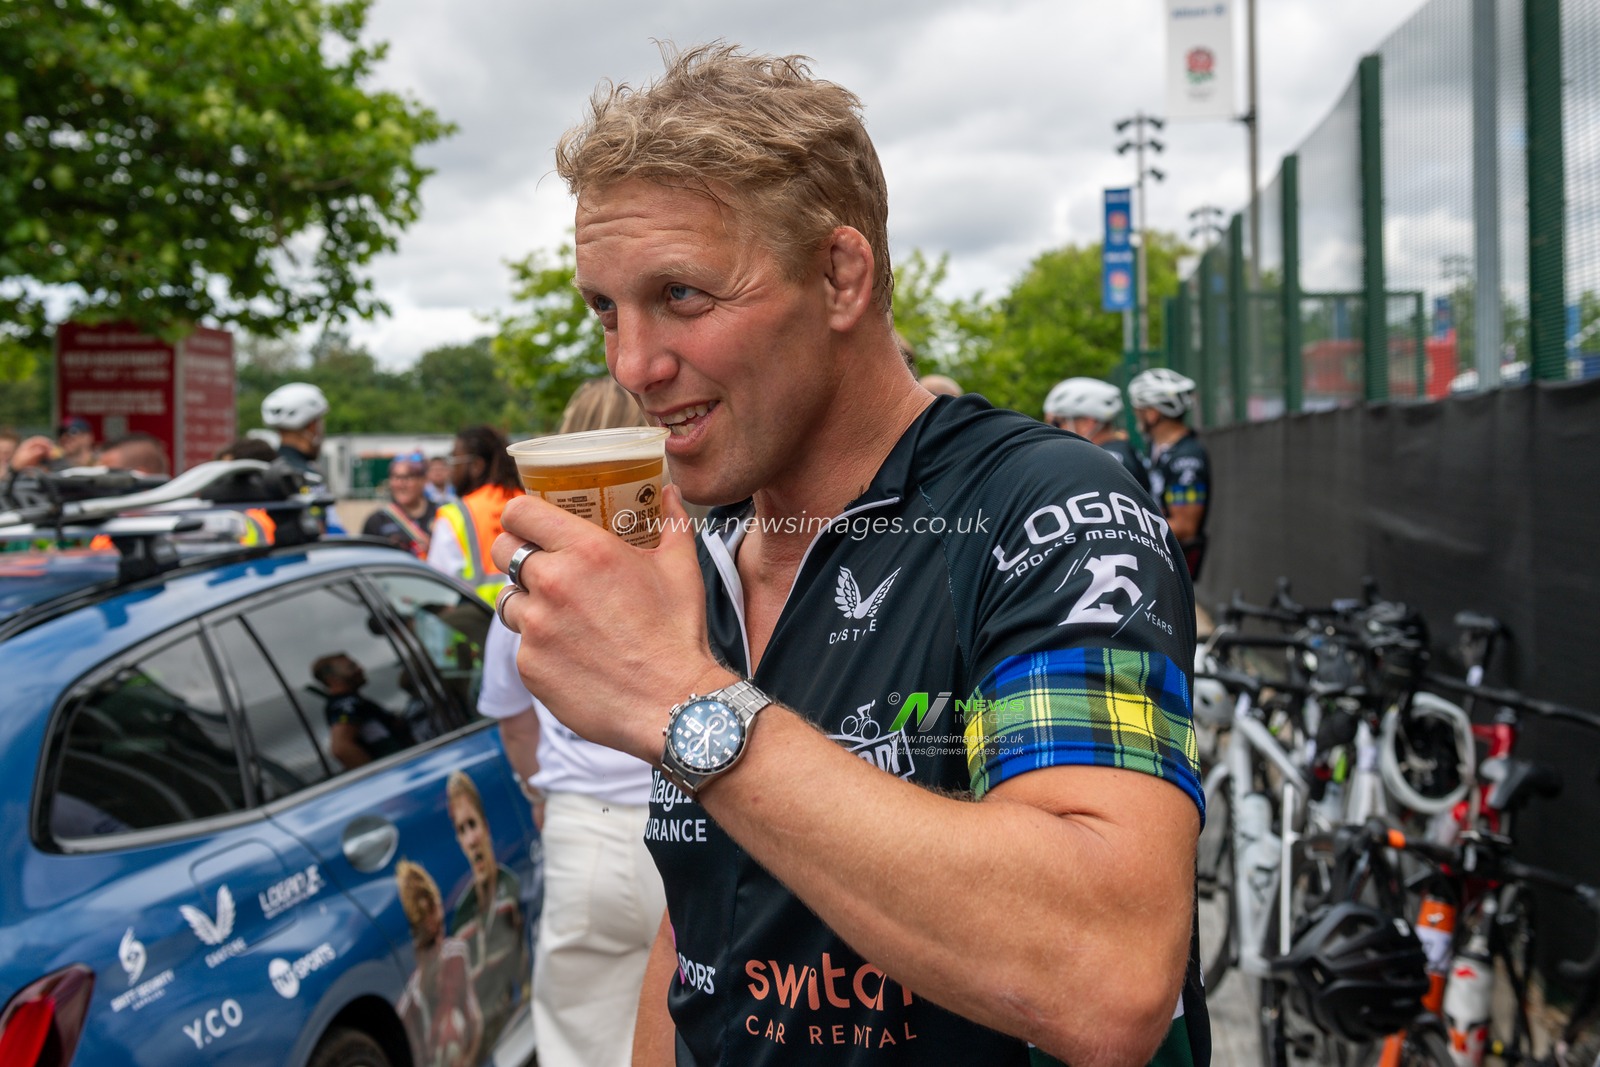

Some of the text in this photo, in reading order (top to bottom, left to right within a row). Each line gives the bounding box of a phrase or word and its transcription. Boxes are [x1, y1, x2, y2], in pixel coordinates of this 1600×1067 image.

[992, 491, 1172, 571] LOGAN
[1085, 528, 1175, 573] marketing
[1144, 611, 1174, 636] YEARS
[183, 998, 243, 1049] Y.CO
[745, 1015, 918, 1049] CAR RENTAL
